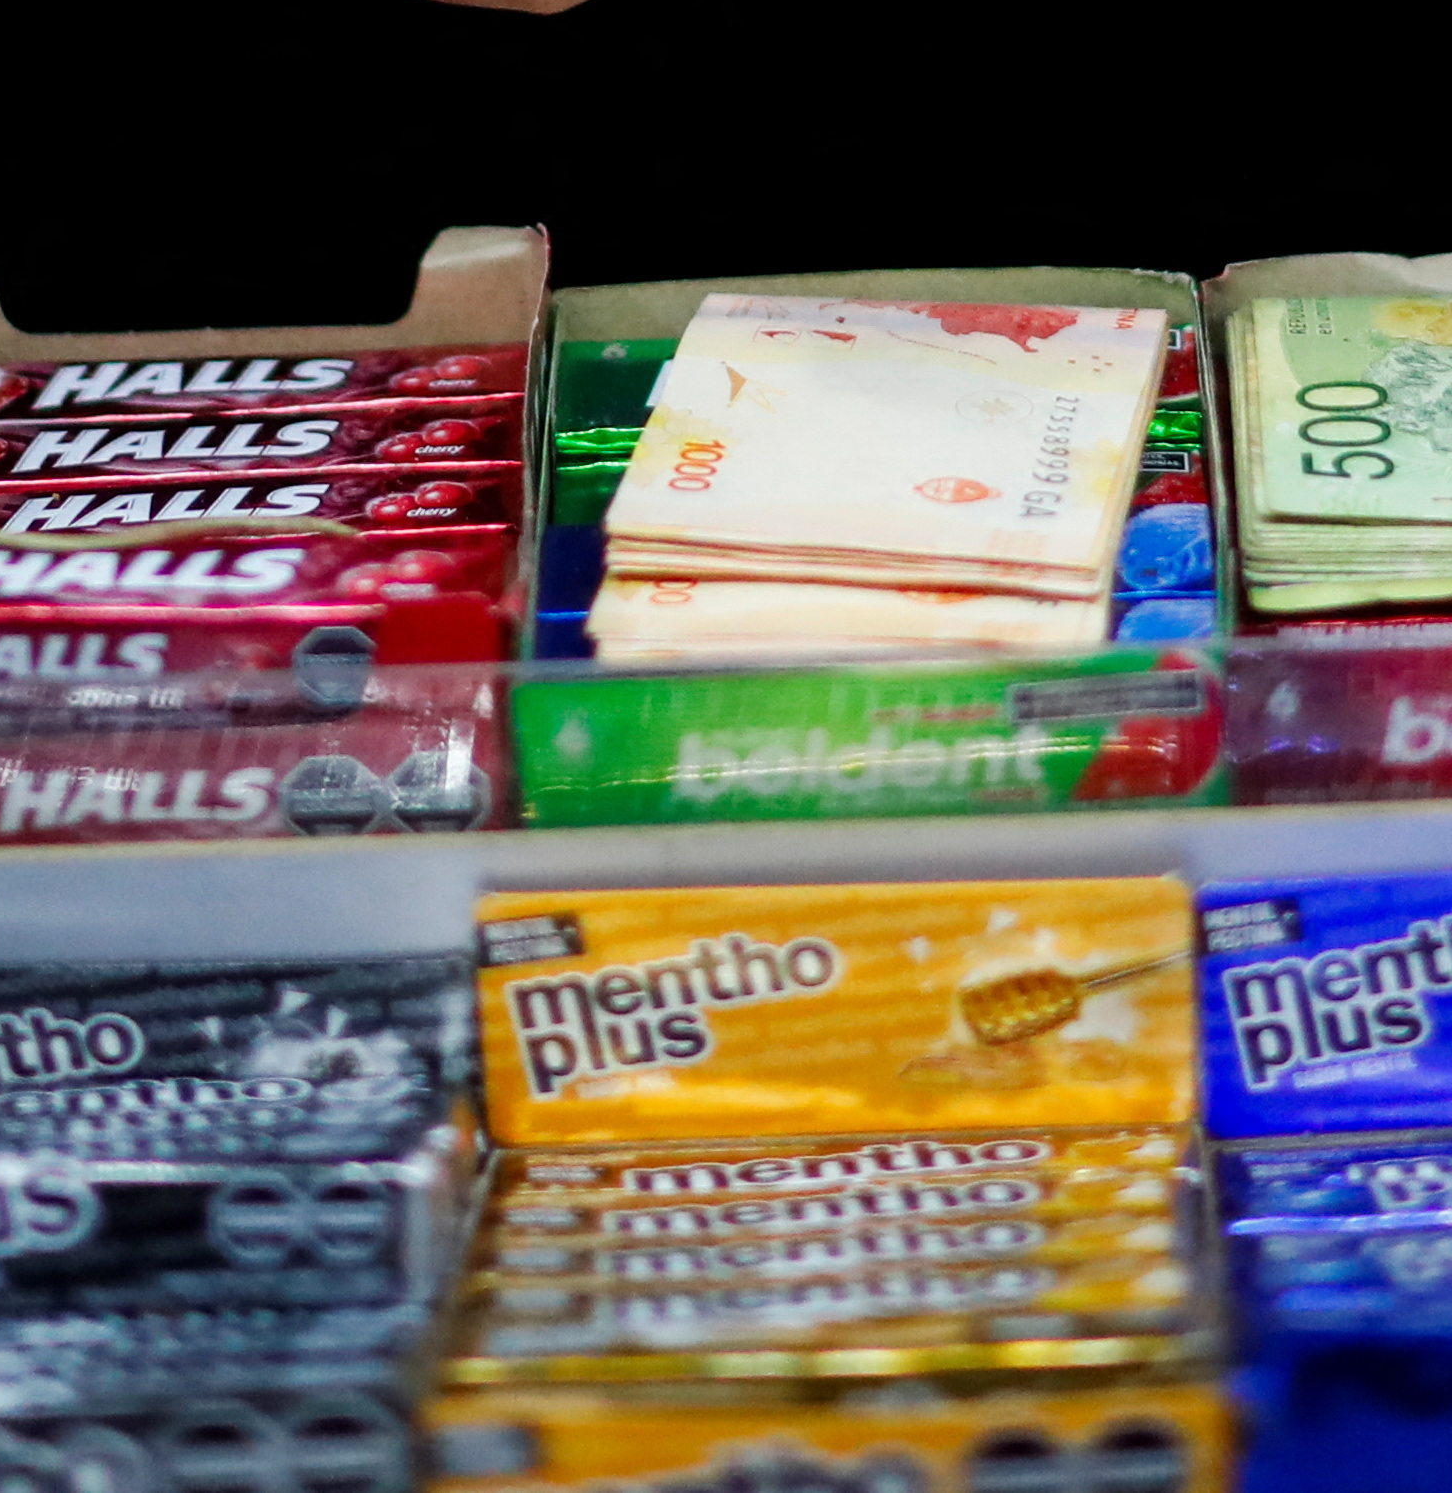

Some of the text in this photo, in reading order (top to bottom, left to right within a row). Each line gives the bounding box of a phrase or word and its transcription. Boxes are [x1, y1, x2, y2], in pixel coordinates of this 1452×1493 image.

[32, 358, 354, 409] HALLS
[11, 420, 465, 473] HALLS cherry
[1295, 380, 1395, 480] 500
[667, 440, 726, 491] 1000
[1, 484, 457, 533] HALLS cherry
[674, 723, 1048, 801] beldent
[510, 932, 838, 1029] mentho
[523, 982, 710, 1097] plus
[1242, 969, 1432, 1091] plus
[623, 1139, 1050, 1193] mentho
[603, 1179, 1040, 1236] mentho
